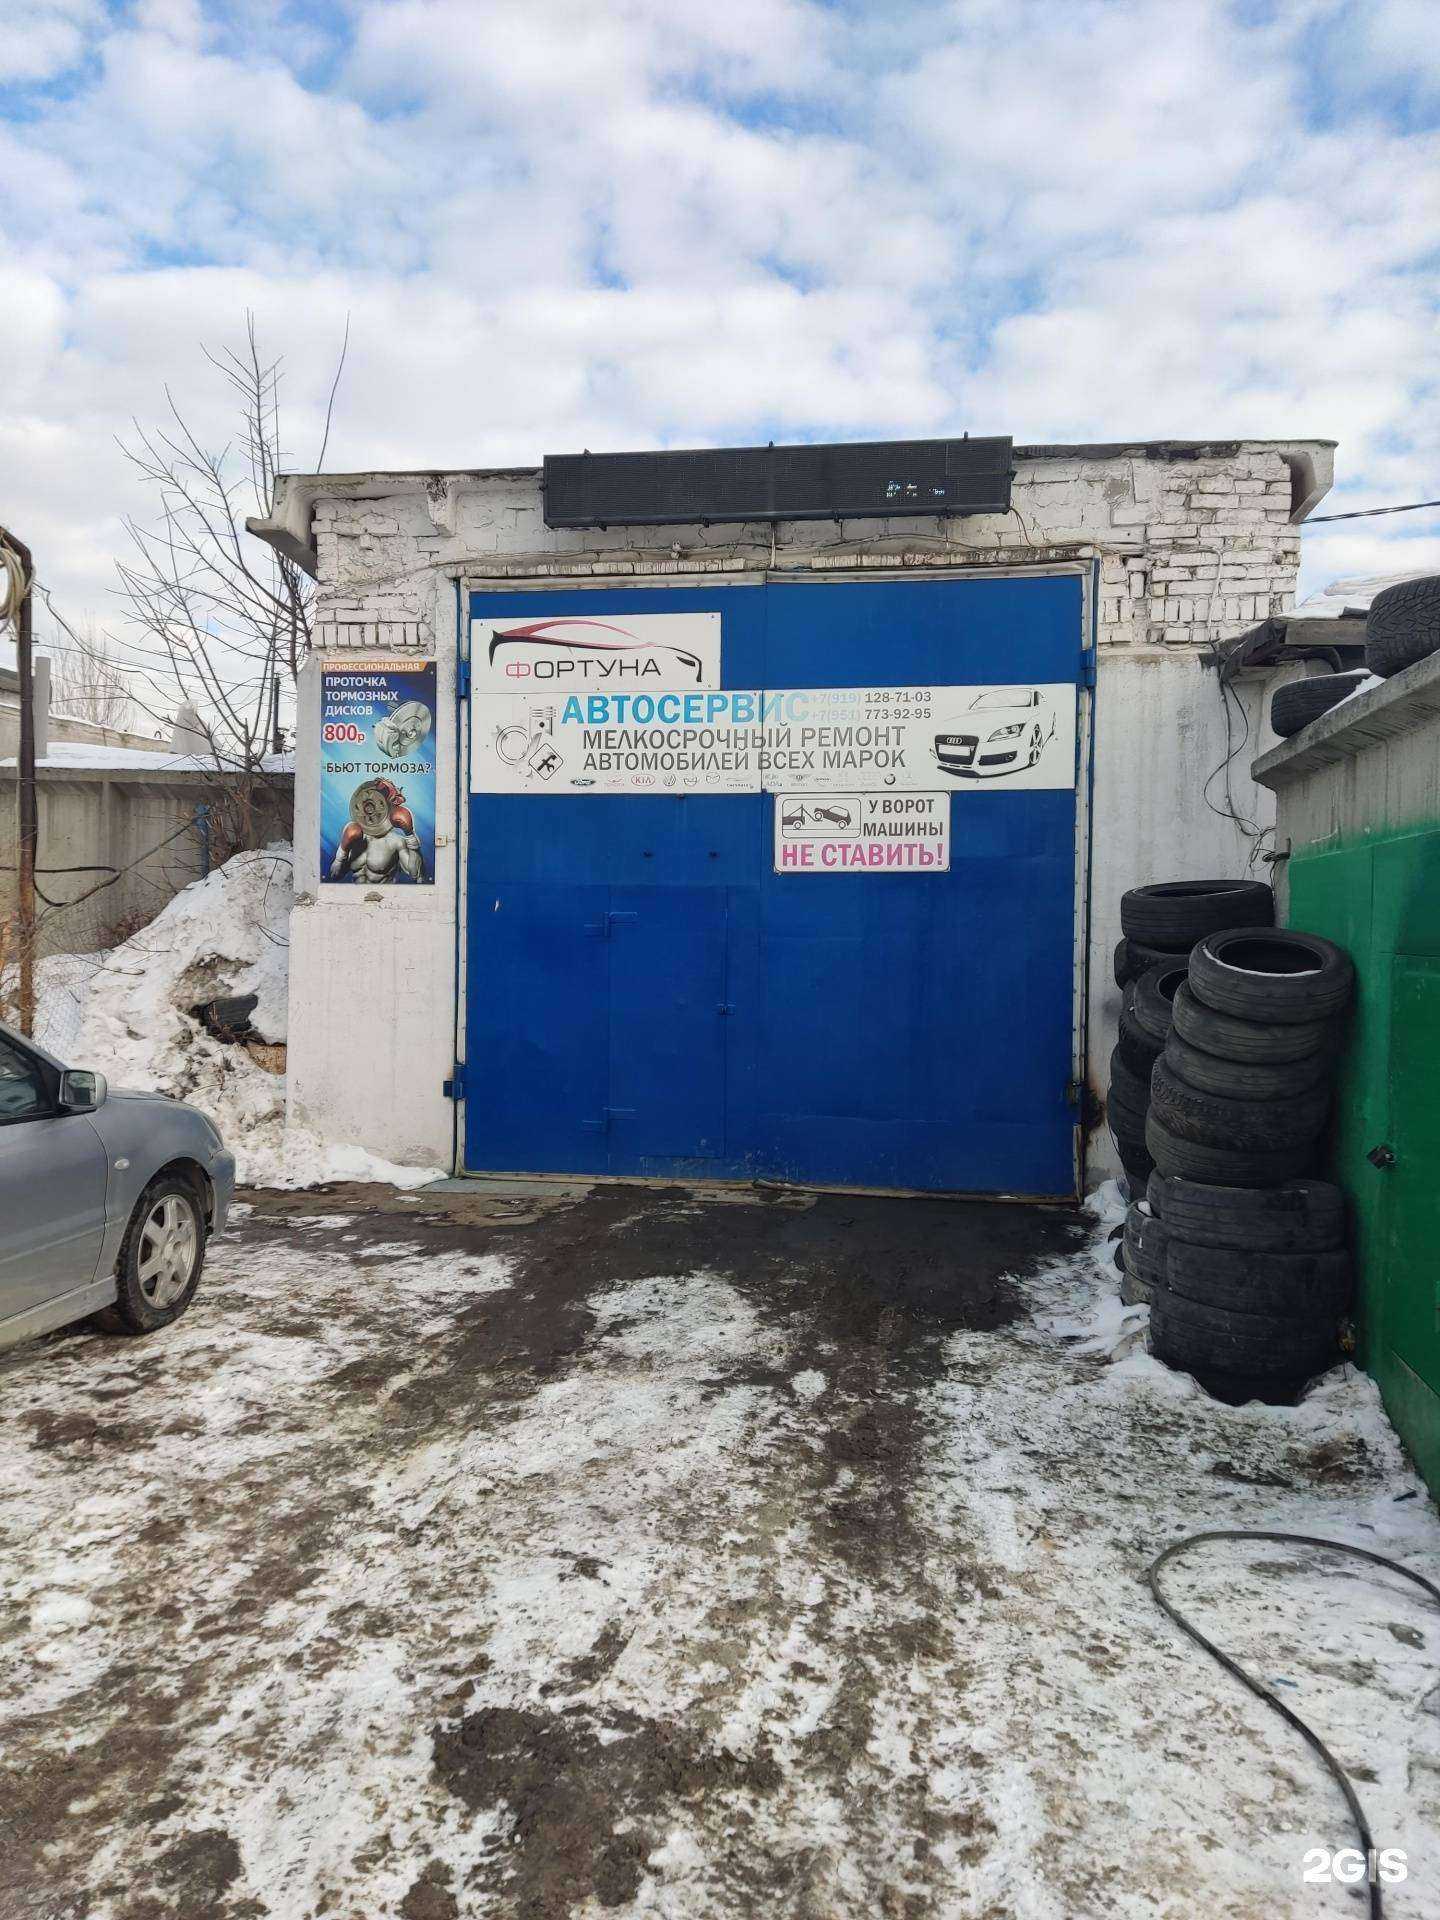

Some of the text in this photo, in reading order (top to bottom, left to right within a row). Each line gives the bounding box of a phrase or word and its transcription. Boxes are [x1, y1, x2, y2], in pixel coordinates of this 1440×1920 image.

[323, 662, 420, 671] ПРОФЕССИОНАЛЬНАЯ
[506, 659, 661, 678] ФОРТУНА
[325, 676, 387, 687] ПРОТОЧКА
[325, 691, 399, 701] ТОРМОЗНЫХ
[864, 691, 932, 703] 128-71-03
[325, 705, 373, 717] ДИСКОВ
[561, 691, 808, 724] АВТОСЕРВИС
[864, 708, 932, 719] 773-92-95
[324, 724, 365, 743] 800р
[583, 722, 906, 751] МЕЛКОСРОЧНЫЙ РЕМОНТ
[583, 745, 907, 771] АВТОМОБИЛЕЙ ВСЕХ МАРОК
[326, 762, 431, 774] БЬЮТ ТОРМОЗА?
[868, 799, 935, 814] У ВОРОТ
[863, 821, 943, 836] МАШИНЫ
[782, 843, 943, 867] НЕ СТАВИТЬ!
